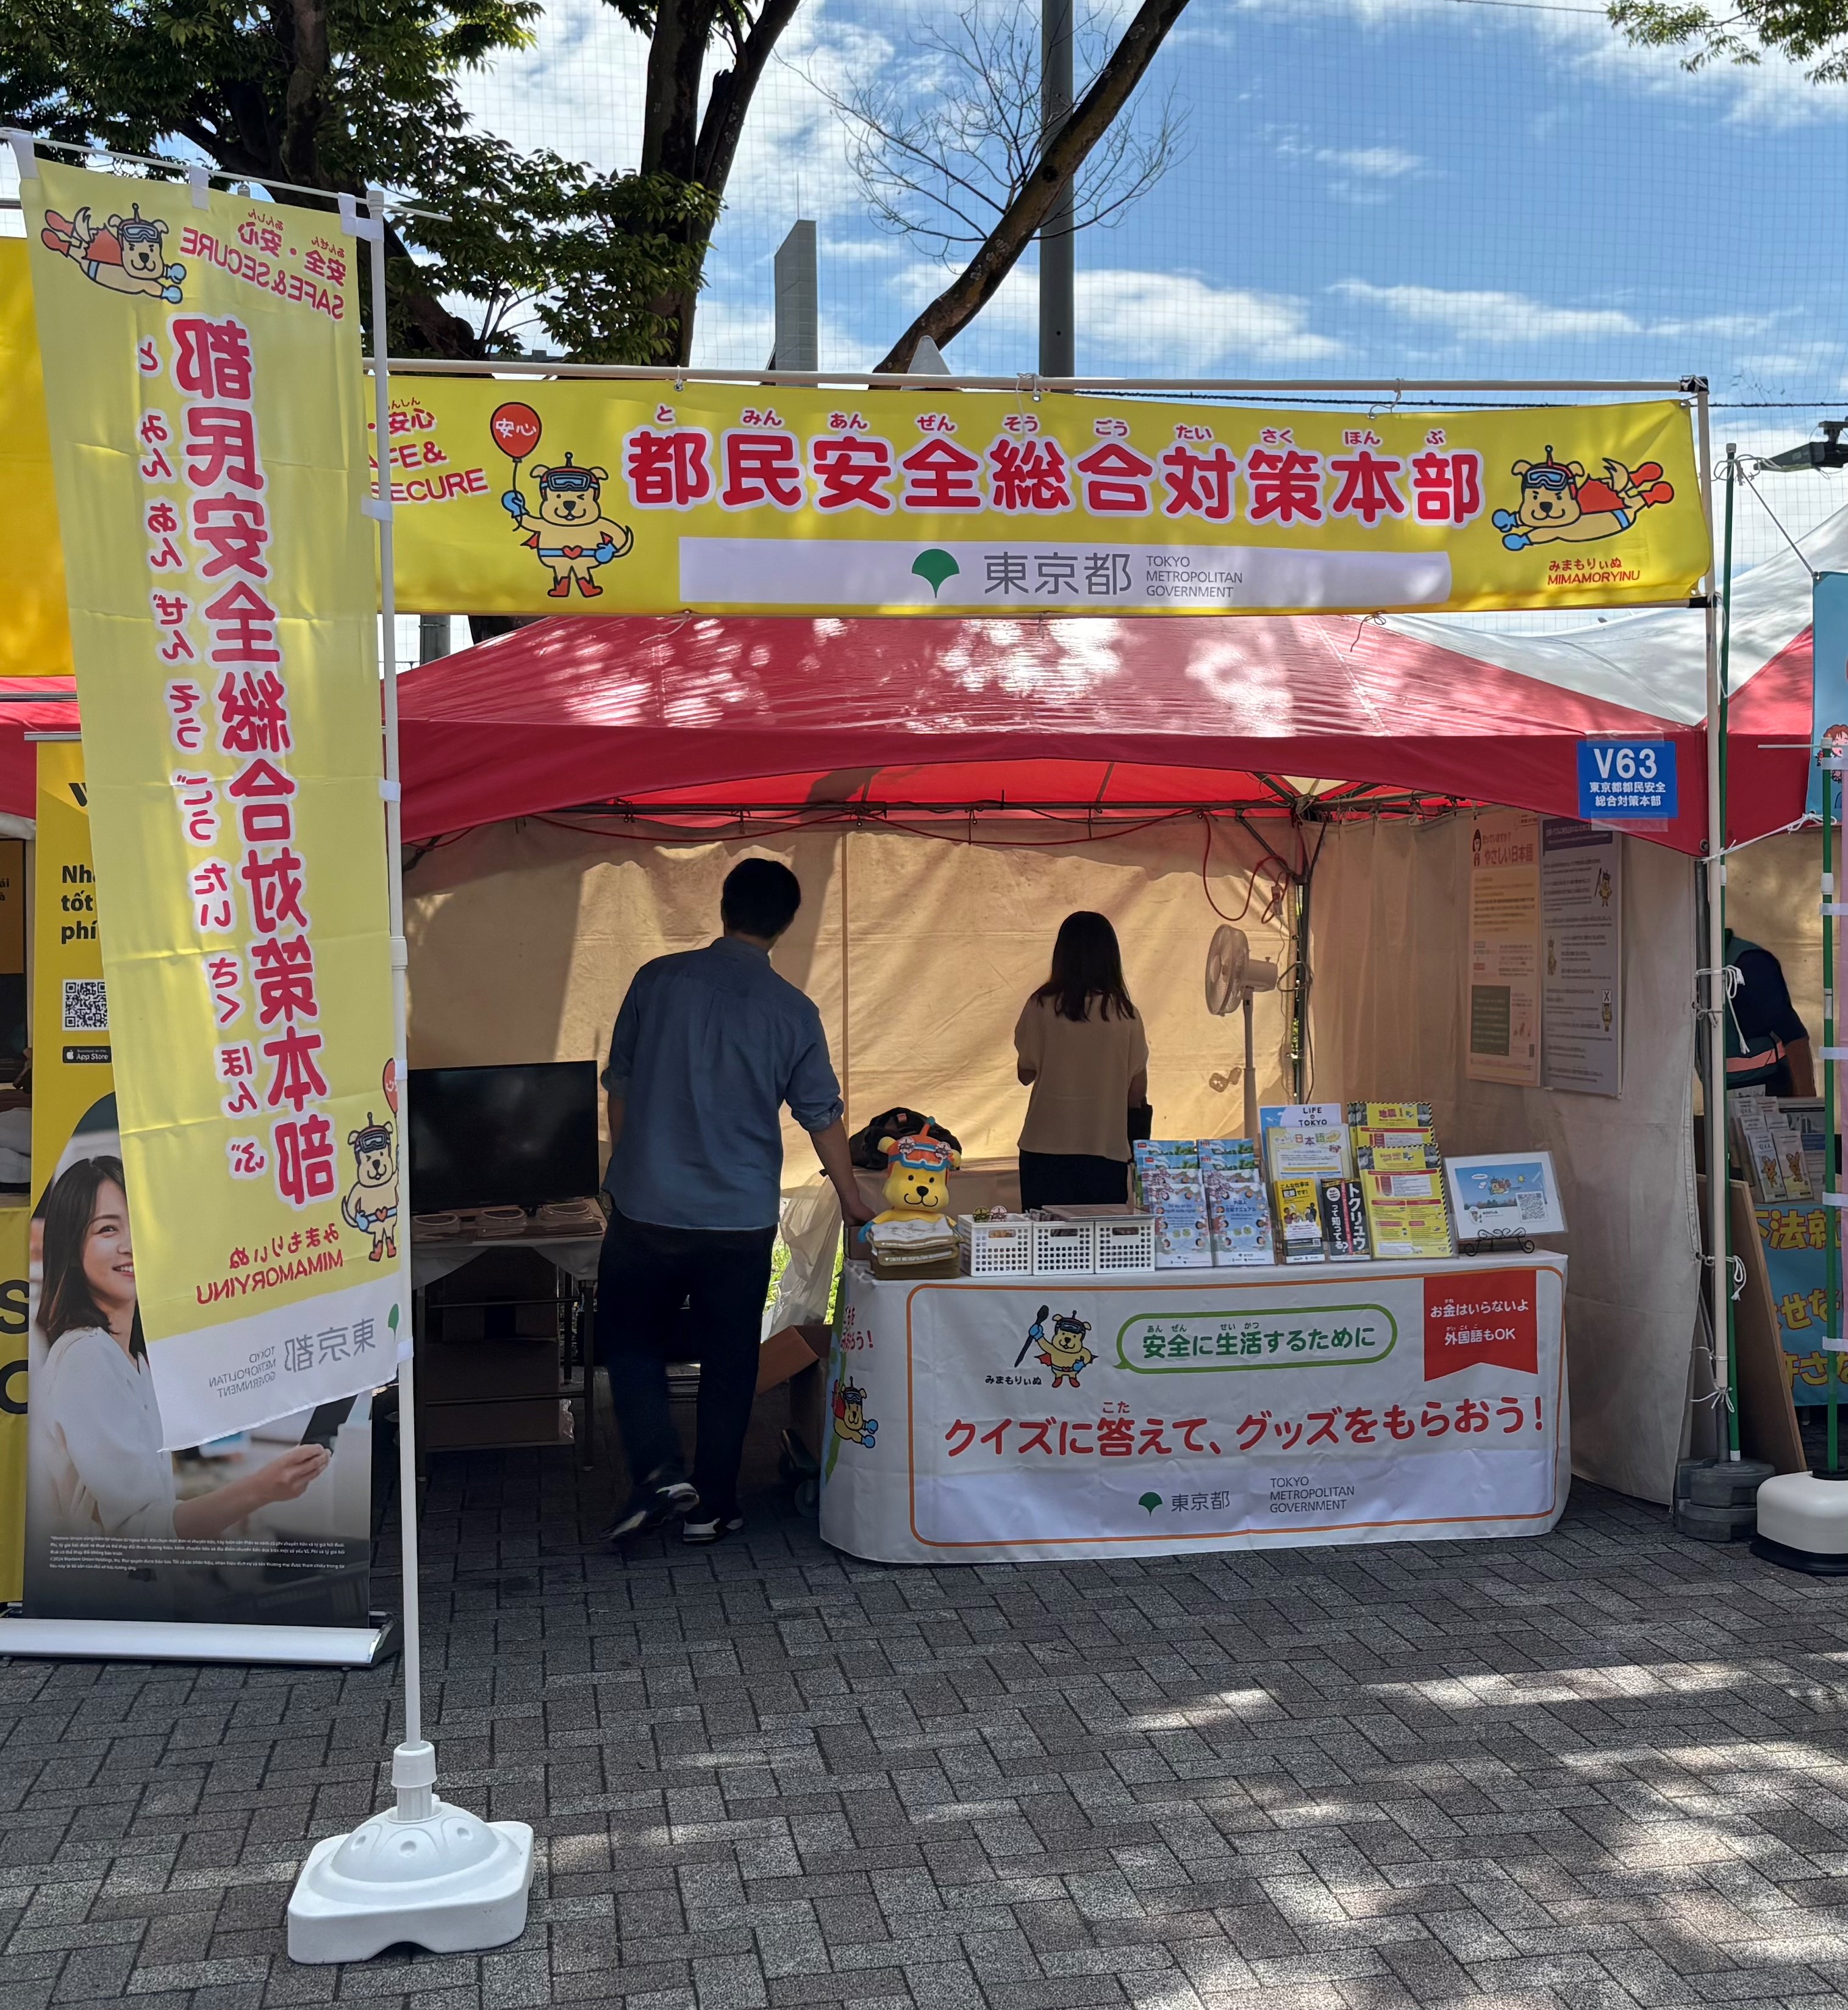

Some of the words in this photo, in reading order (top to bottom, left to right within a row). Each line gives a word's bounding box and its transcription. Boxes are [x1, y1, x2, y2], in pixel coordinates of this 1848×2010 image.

[389, 397, 420, 410] んしん
[495, 418, 537, 438] 安心
[656, 405, 673, 422] と
[742, 408, 783, 426] みん
[829, 412, 868, 429] あん
[917, 414, 956, 432] ぜん
[1004, 415, 1038, 432] そう
[1095, 420, 1129, 437] ごう
[1175, 424, 1213, 441] たい
[1261, 428, 1294, 444] さく
[1344, 429, 1381, 446] ほん
[1427, 429, 1444, 445] ぶ
[628, 430, 1483, 525] 都民安全総合対策本部
[1146, 556, 1190, 568] TOKYO
[984, 551, 1132, 596] 東京都
[1147, 570, 1243, 584] METROPOLITAN
[1547, 570, 1641, 585] MIMAMORYINU
[1147, 585, 1234, 598] GOVERNMENT
[1594, 748, 1658, 779] V63
[1589, 781, 1666, 793] 東京都都民安全
[1595, 795, 1661, 807] 総合対策本部
[62, 864, 96, 883] Nh
[61, 890, 93, 912] tốt
[61, 920, 98, 945] phí
[1430, 1299, 1528, 1318] お金はいらないよ
[1147, 1325, 1162, 1333] あん
[1445, 1328, 1516, 1345] 外国語もOK
[1143, 1327, 1375, 1359] 安全に生活するために
[1103, 1401, 1130, 1414] こた
[1270, 1476, 1309, 1488] TOKYO
[1171, 1490, 1230, 1512] 東京都
[1270, 1487, 1355, 1500] METROPOLITAN
[1270, 1500, 1347, 1512] GOVERNMENT
